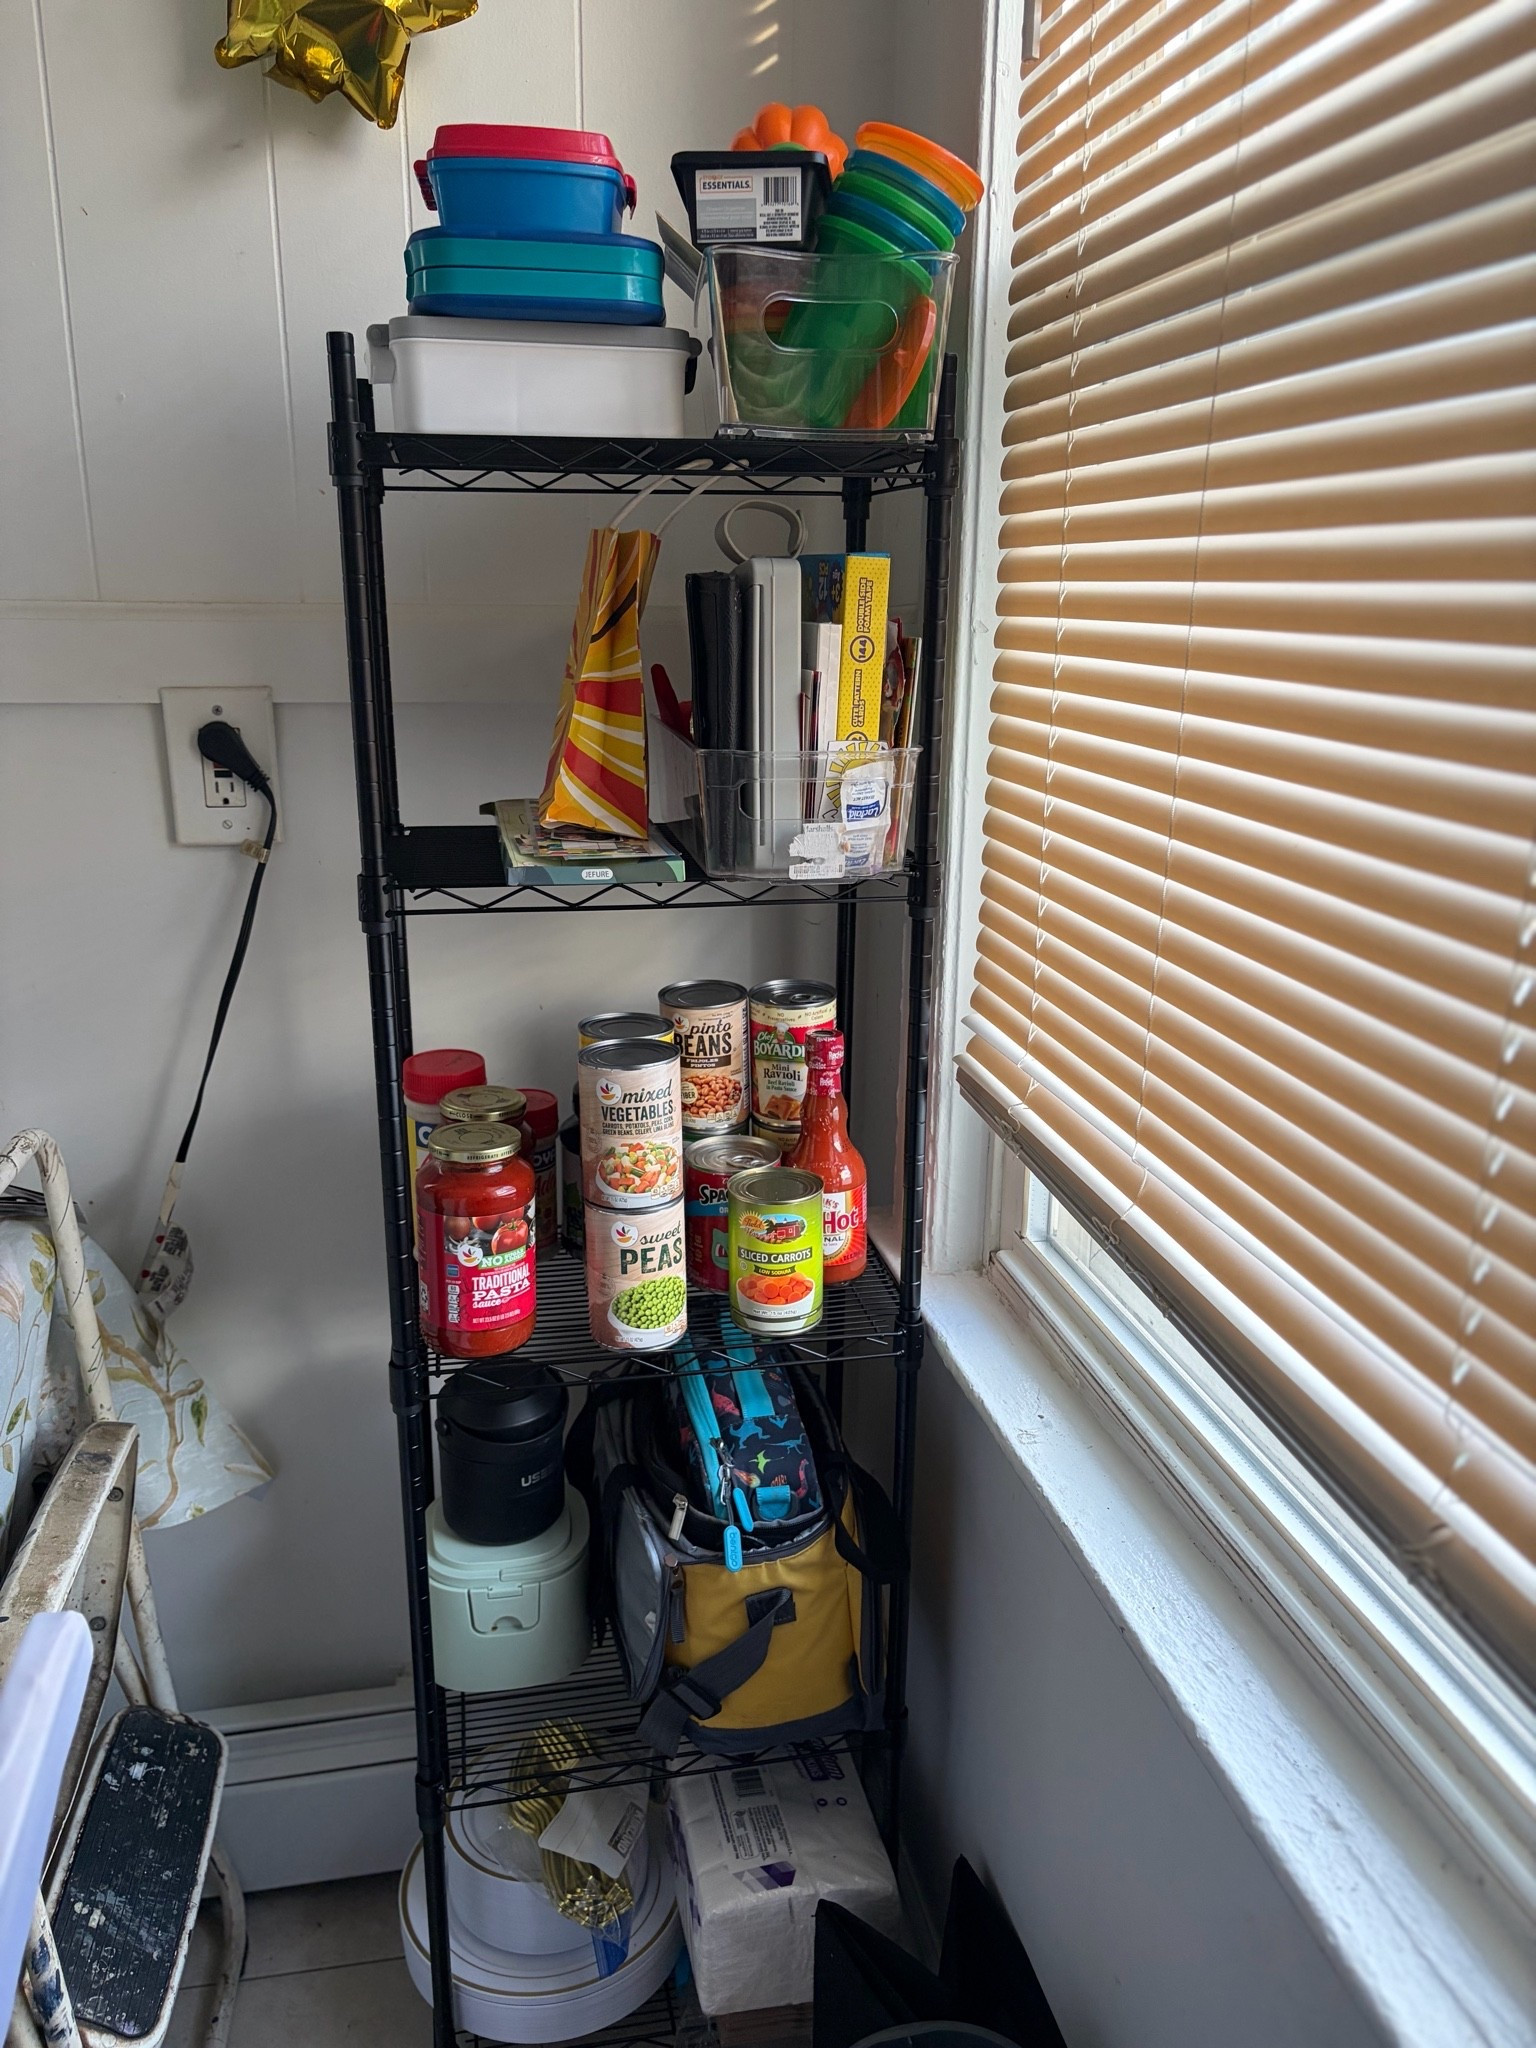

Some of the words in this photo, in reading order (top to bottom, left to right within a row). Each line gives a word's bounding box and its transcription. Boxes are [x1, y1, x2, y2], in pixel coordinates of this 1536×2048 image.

[702, 180, 751, 190] ESSENTIALS
[858, 577, 867, 598] SIDE
[865, 579, 874, 603] TAPE
[856, 598, 866, 633] DOUBLE
[863, 604, 872, 633] FOAM
[858, 640, 867, 659] 144
[853, 669, 862, 705] PATTERN
[851, 704, 859, 728] CUTE
[857, 699, 866, 728] CARDS
[848, 806, 880, 819] Lactaid
[690, 1019, 733, 1035] pinto
[757, 1031, 775, 1044] Chef
[674, 1032, 732, 1057] BEANS
[763, 1067, 801, 1081] Ravioli
[771, 1063, 790, 1072] Mini
[621, 1079, 673, 1104] mixed
[681, 1091, 696, 1099] IBER
[601, 1100, 674, 1122] VEGETABLES
[602, 1128, 617, 1136] GREEN
[823, 1197, 839, 1209] K'S
[639, 1220, 681, 1246] sweet
[481, 1256, 504, 1268] NO
[620, 1236, 683, 1275] PEAS
[740, 1248, 769, 1263] SLICED
[770, 1248, 811, 1263] CARROTS
[472, 1263, 531, 1291] TRADITIONAL
[472, 1278, 531, 1302] PASTA
[472, 1298, 502, 1309] sauce
[729, 1531, 739, 1567] bentgo
